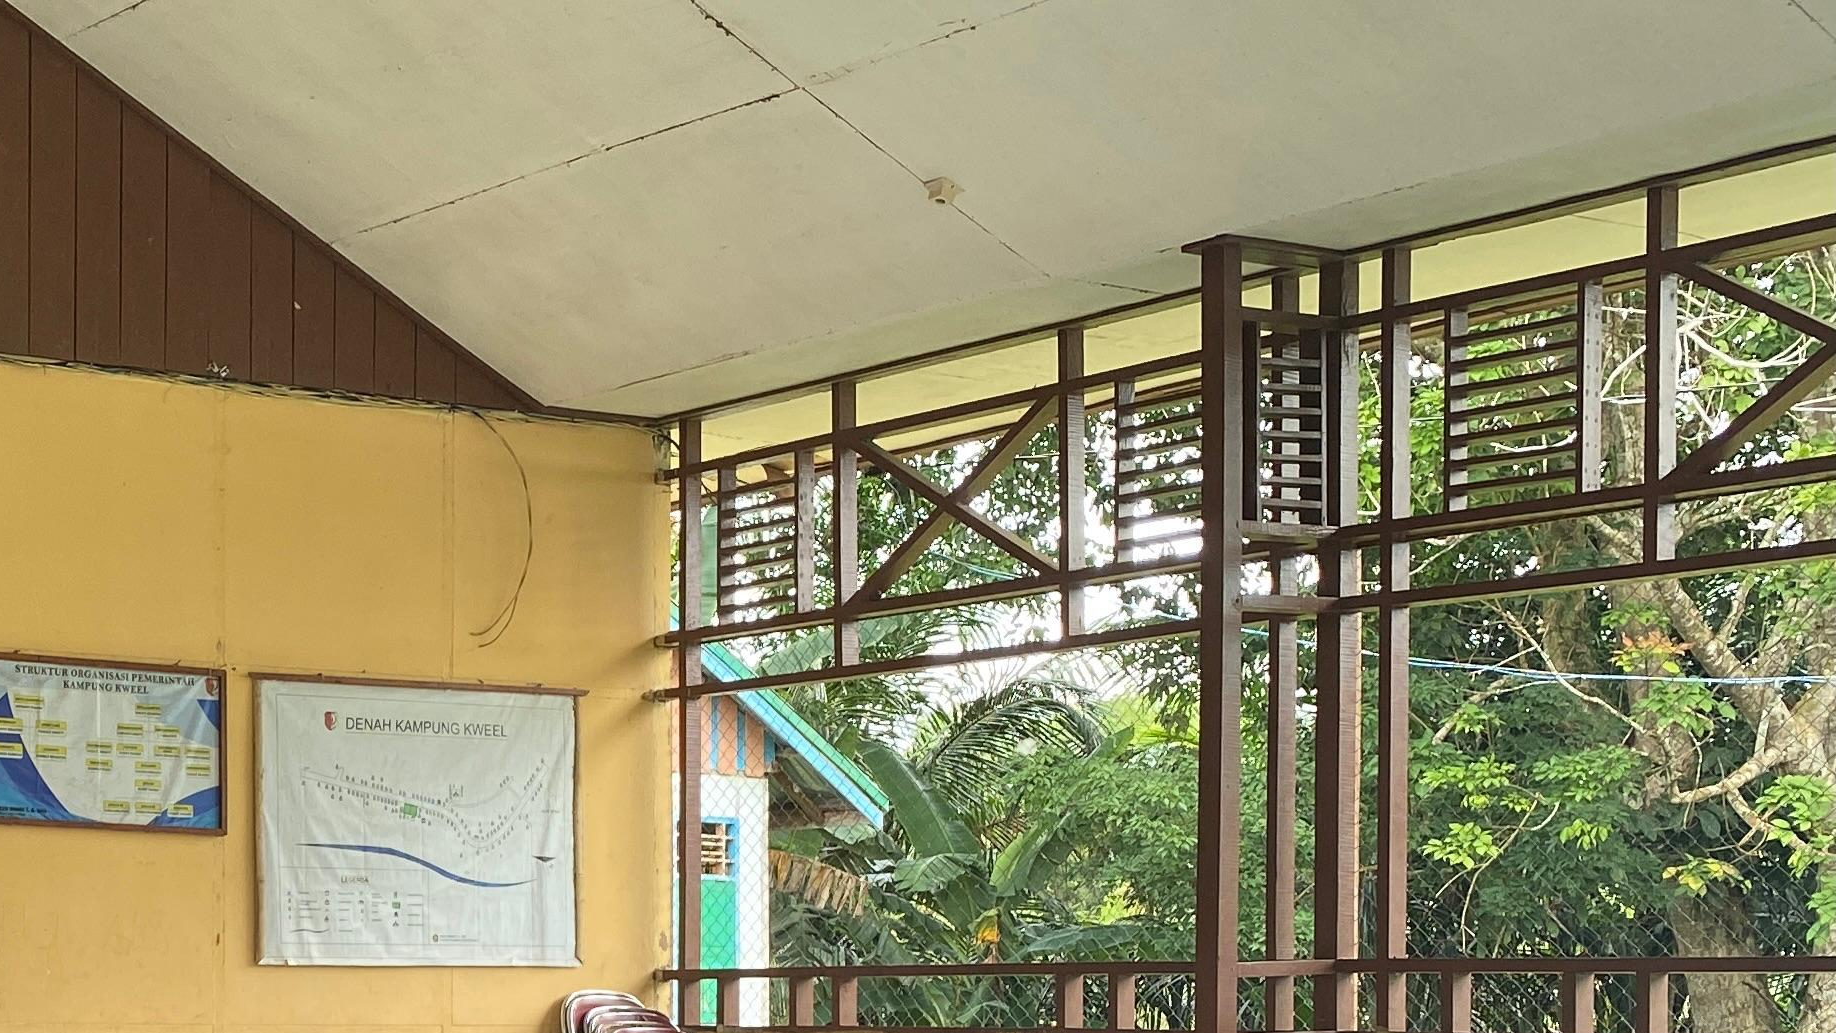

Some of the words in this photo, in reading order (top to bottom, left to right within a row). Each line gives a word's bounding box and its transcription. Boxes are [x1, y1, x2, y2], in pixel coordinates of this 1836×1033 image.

[15, 664, 69, 677] STRUKTUR
[71, 669, 130, 682] ORGANISASI
[131, 673, 195, 687] PEMERINTAH
[63, 680, 113, 693] KAMPUNG
[115, 683, 150, 694] KWEEL
[345, 717, 392, 732] DENAH
[395, 720, 461, 735] KAMPUNG
[464, 723, 508, 737] KWEEL
